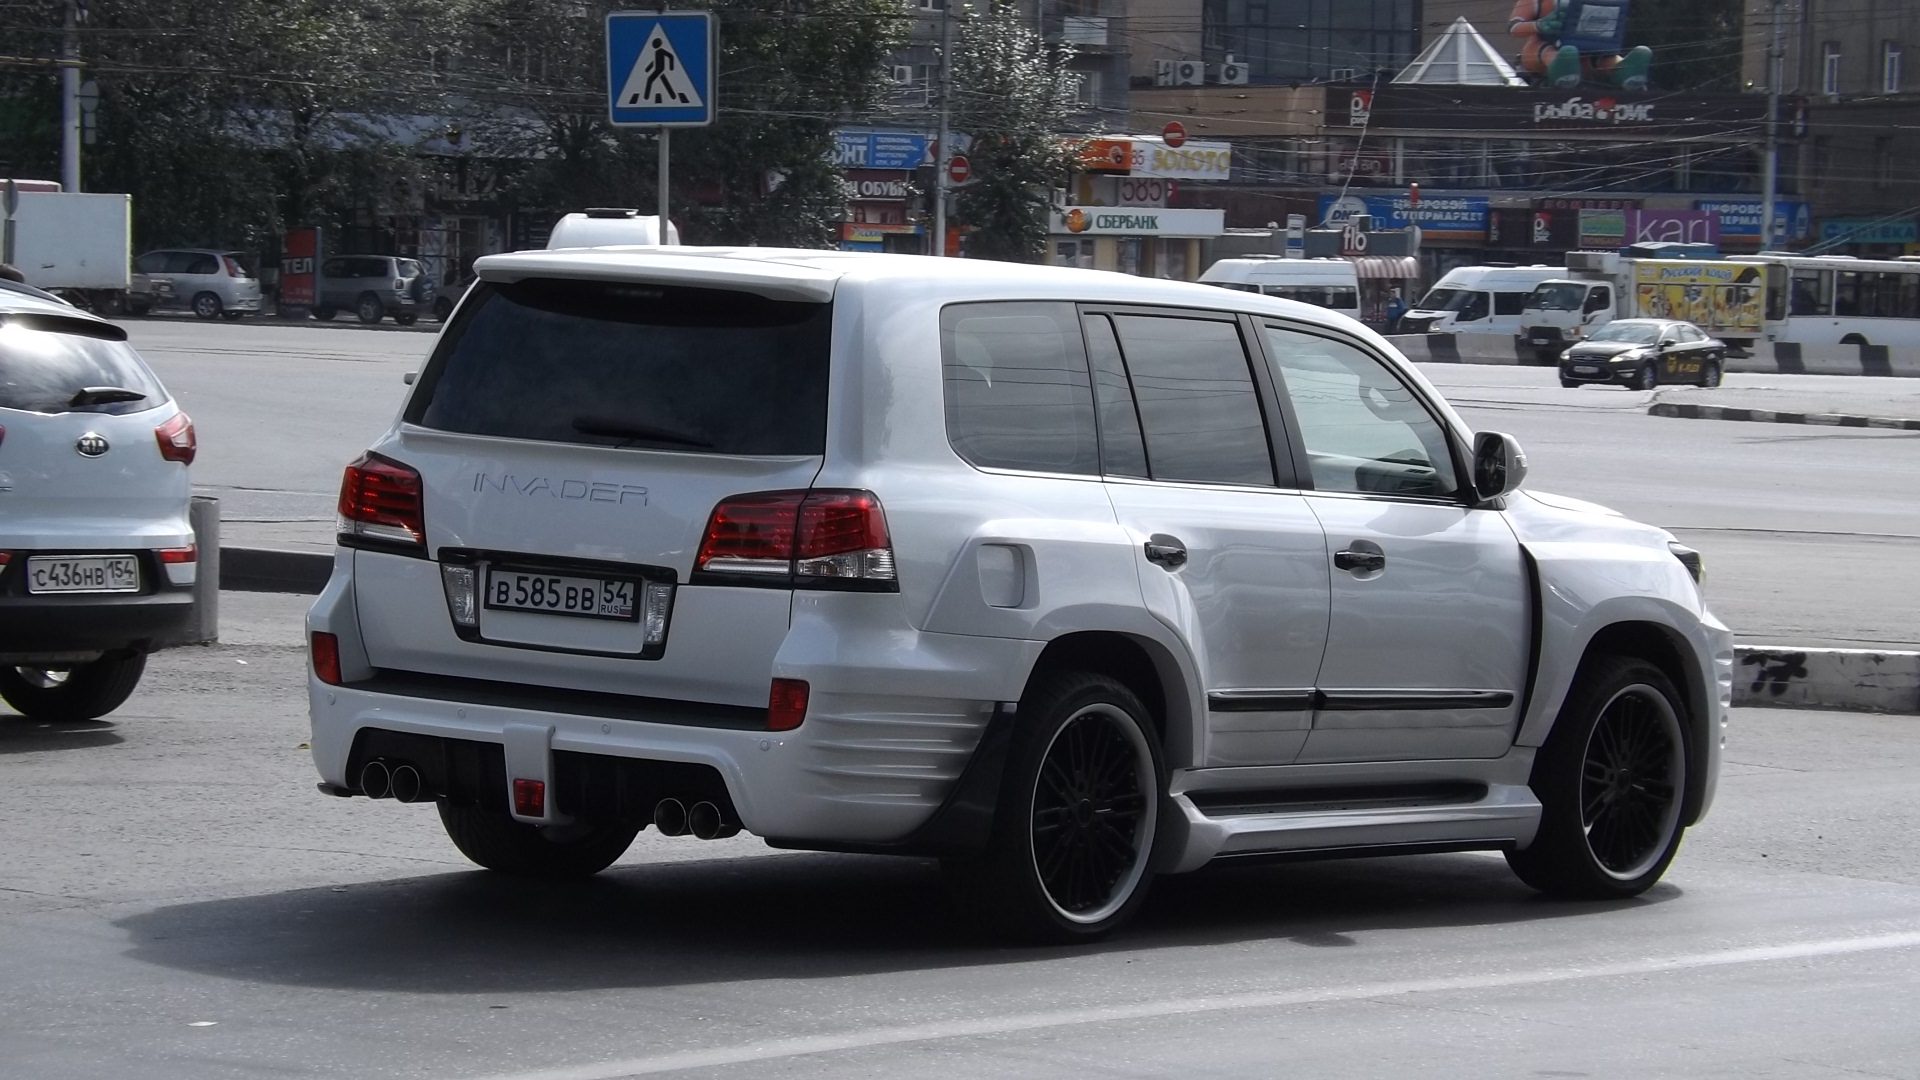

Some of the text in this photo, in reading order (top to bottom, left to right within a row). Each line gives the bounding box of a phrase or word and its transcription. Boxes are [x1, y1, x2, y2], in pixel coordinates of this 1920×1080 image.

[1151, 149, 1231, 172] ЗОЛОТО
[1096, 213, 1159, 230] СБЕРБАНК
[1636, 209, 1711, 244] kari
[473, 472, 649, 506] INVADER
[106, 560, 134, 579] 154
[602, 580, 628, 606] 54
[600, 604, 620, 615] RUS
